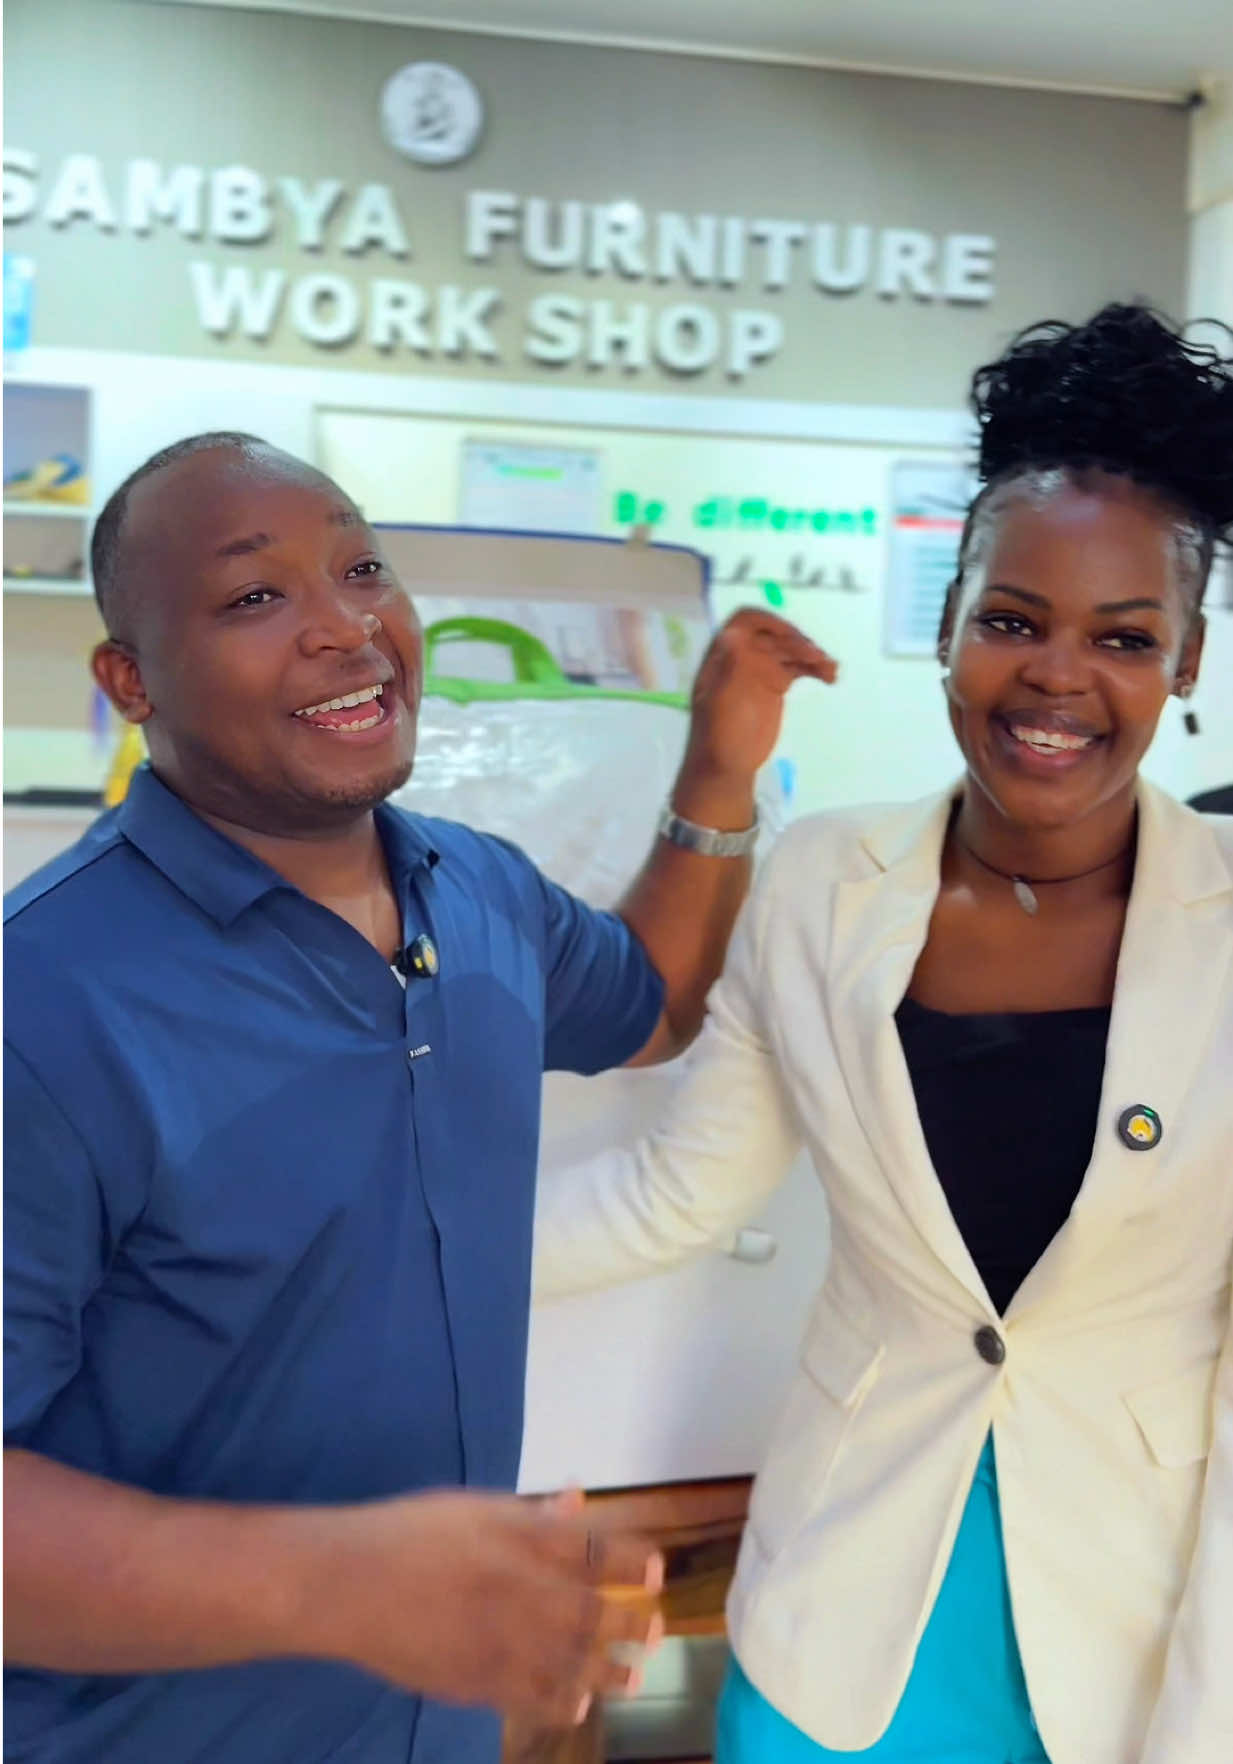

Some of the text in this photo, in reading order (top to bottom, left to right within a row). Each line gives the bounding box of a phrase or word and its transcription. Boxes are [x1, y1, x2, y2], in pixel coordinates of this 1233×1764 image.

[3, 148, 997, 302] SAMBYA FURNITURE
[190, 260, 784, 377] WORK SHOP
[614, 491, 665, 525] Be
[694, 497, 876, 534] different
